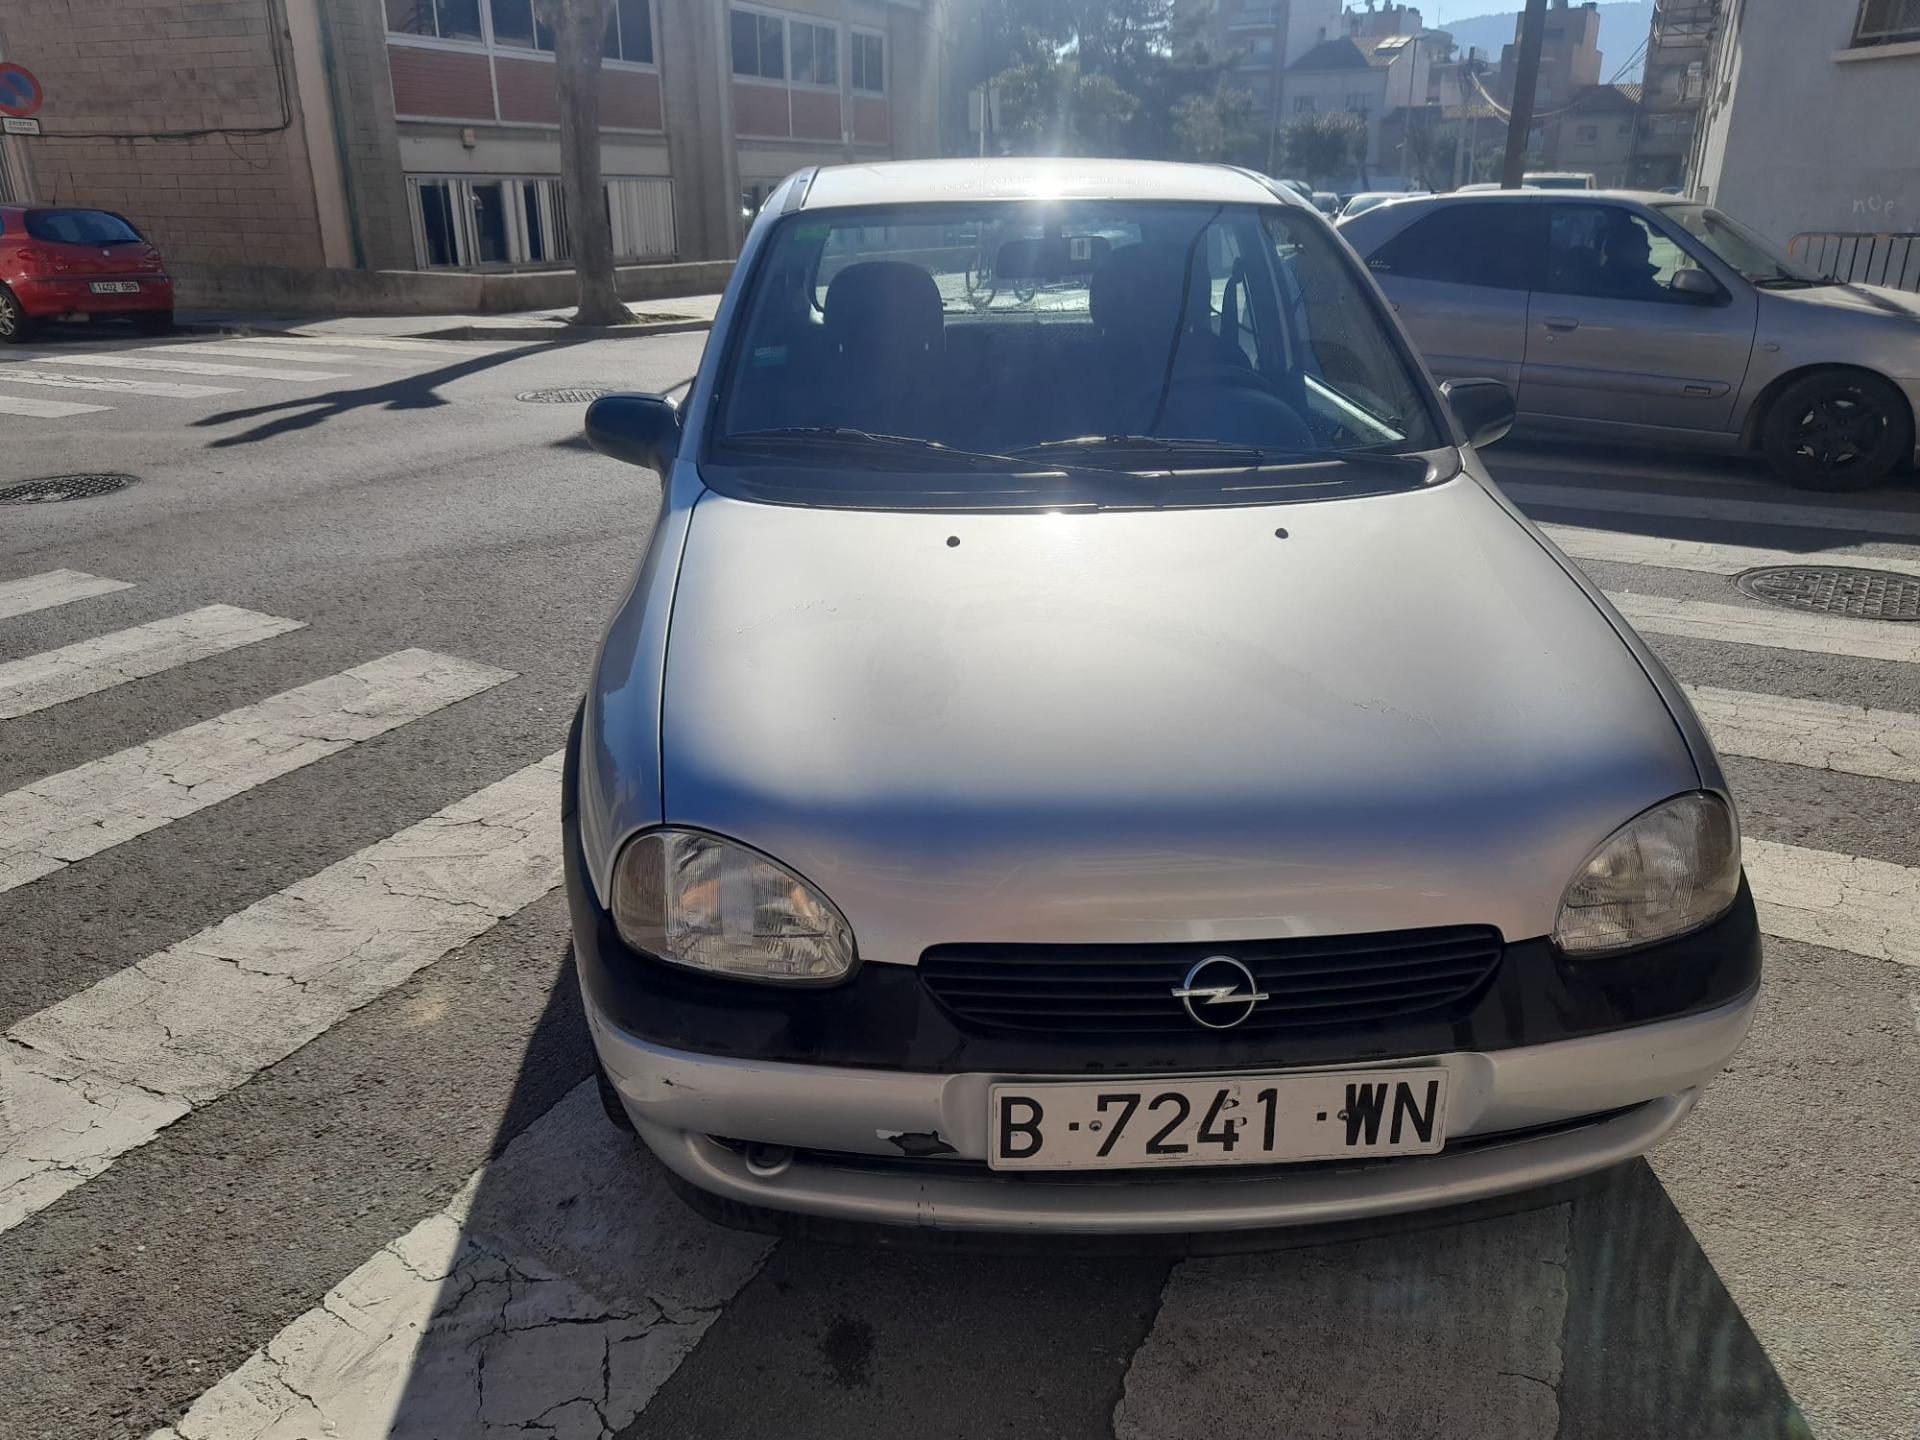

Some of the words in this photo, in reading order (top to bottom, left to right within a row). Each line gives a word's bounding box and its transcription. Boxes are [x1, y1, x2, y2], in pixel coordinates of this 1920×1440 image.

[97, 282, 117, 292] 1402
[1000, 1097, 1044, 1159] B
[1096, 1088, 1277, 1158] 7241
[1345, 1080, 1439, 1146] WN
